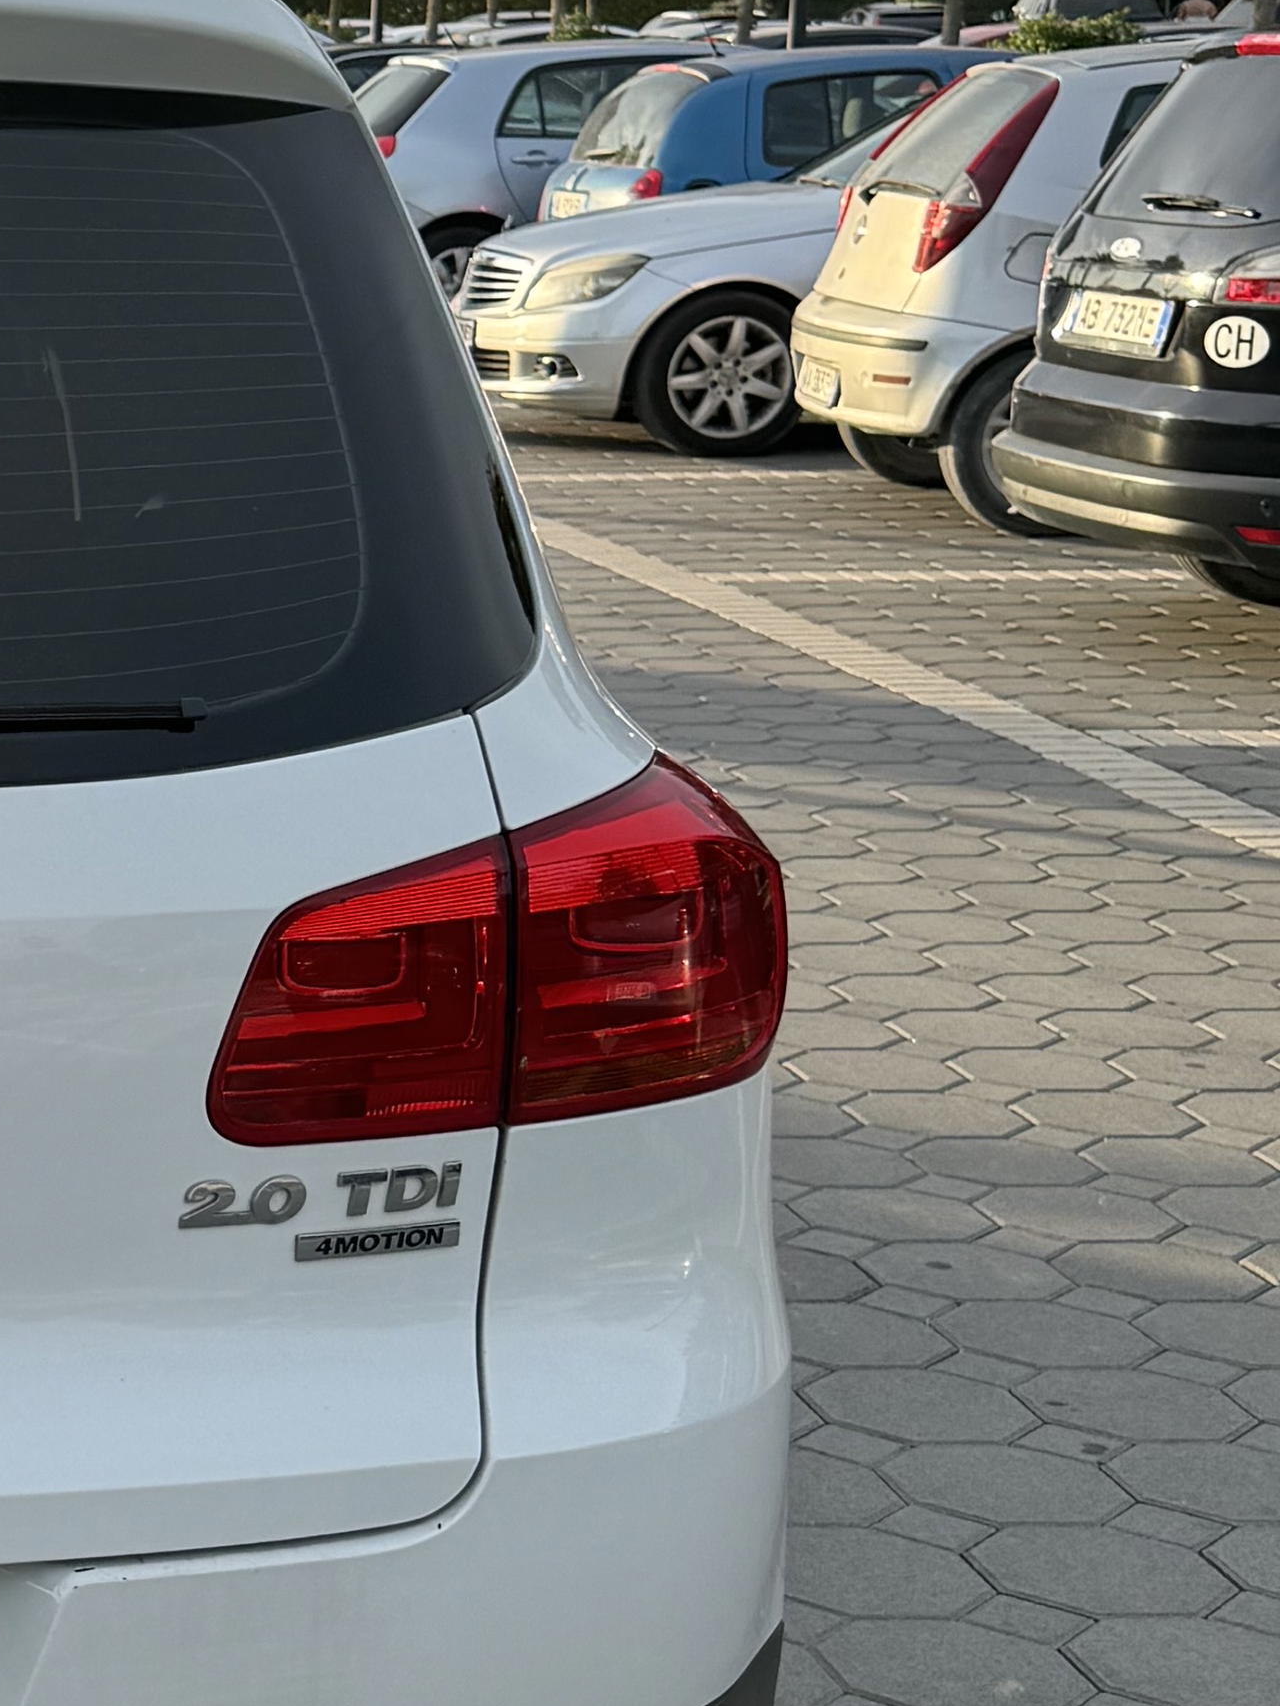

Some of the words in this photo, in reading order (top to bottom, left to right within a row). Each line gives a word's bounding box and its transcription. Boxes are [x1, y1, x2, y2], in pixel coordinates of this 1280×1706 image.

[1213, 323, 1255, 361] CH
[337, 1159, 463, 1218] TDI
[314, 1226, 446, 1256] 4MOTION
